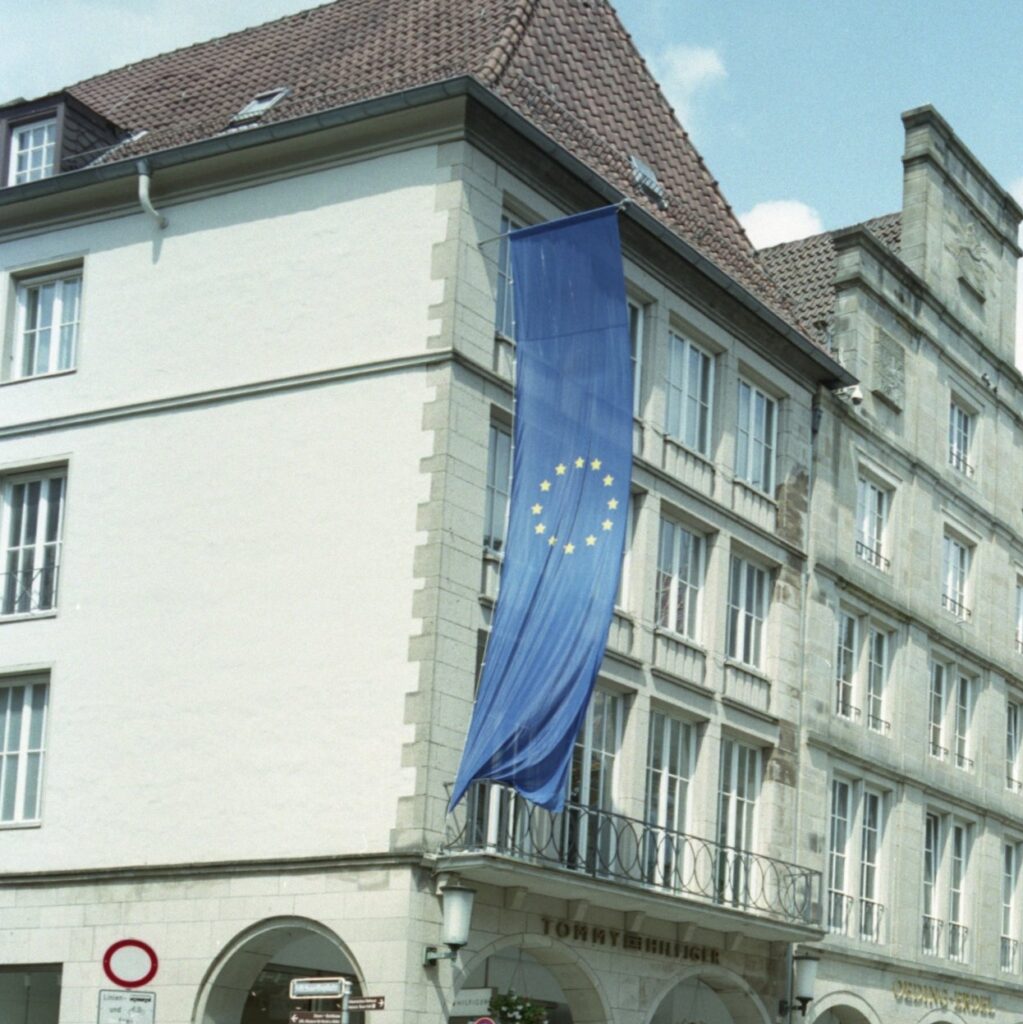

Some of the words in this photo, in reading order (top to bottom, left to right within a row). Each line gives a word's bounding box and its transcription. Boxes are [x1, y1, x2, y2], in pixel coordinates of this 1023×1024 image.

[541, 917, 620, 947] TOMMY
[645, 936, 721, 965] HILFIGER
[892, 979, 995, 1017] OEDING-ERDEL
